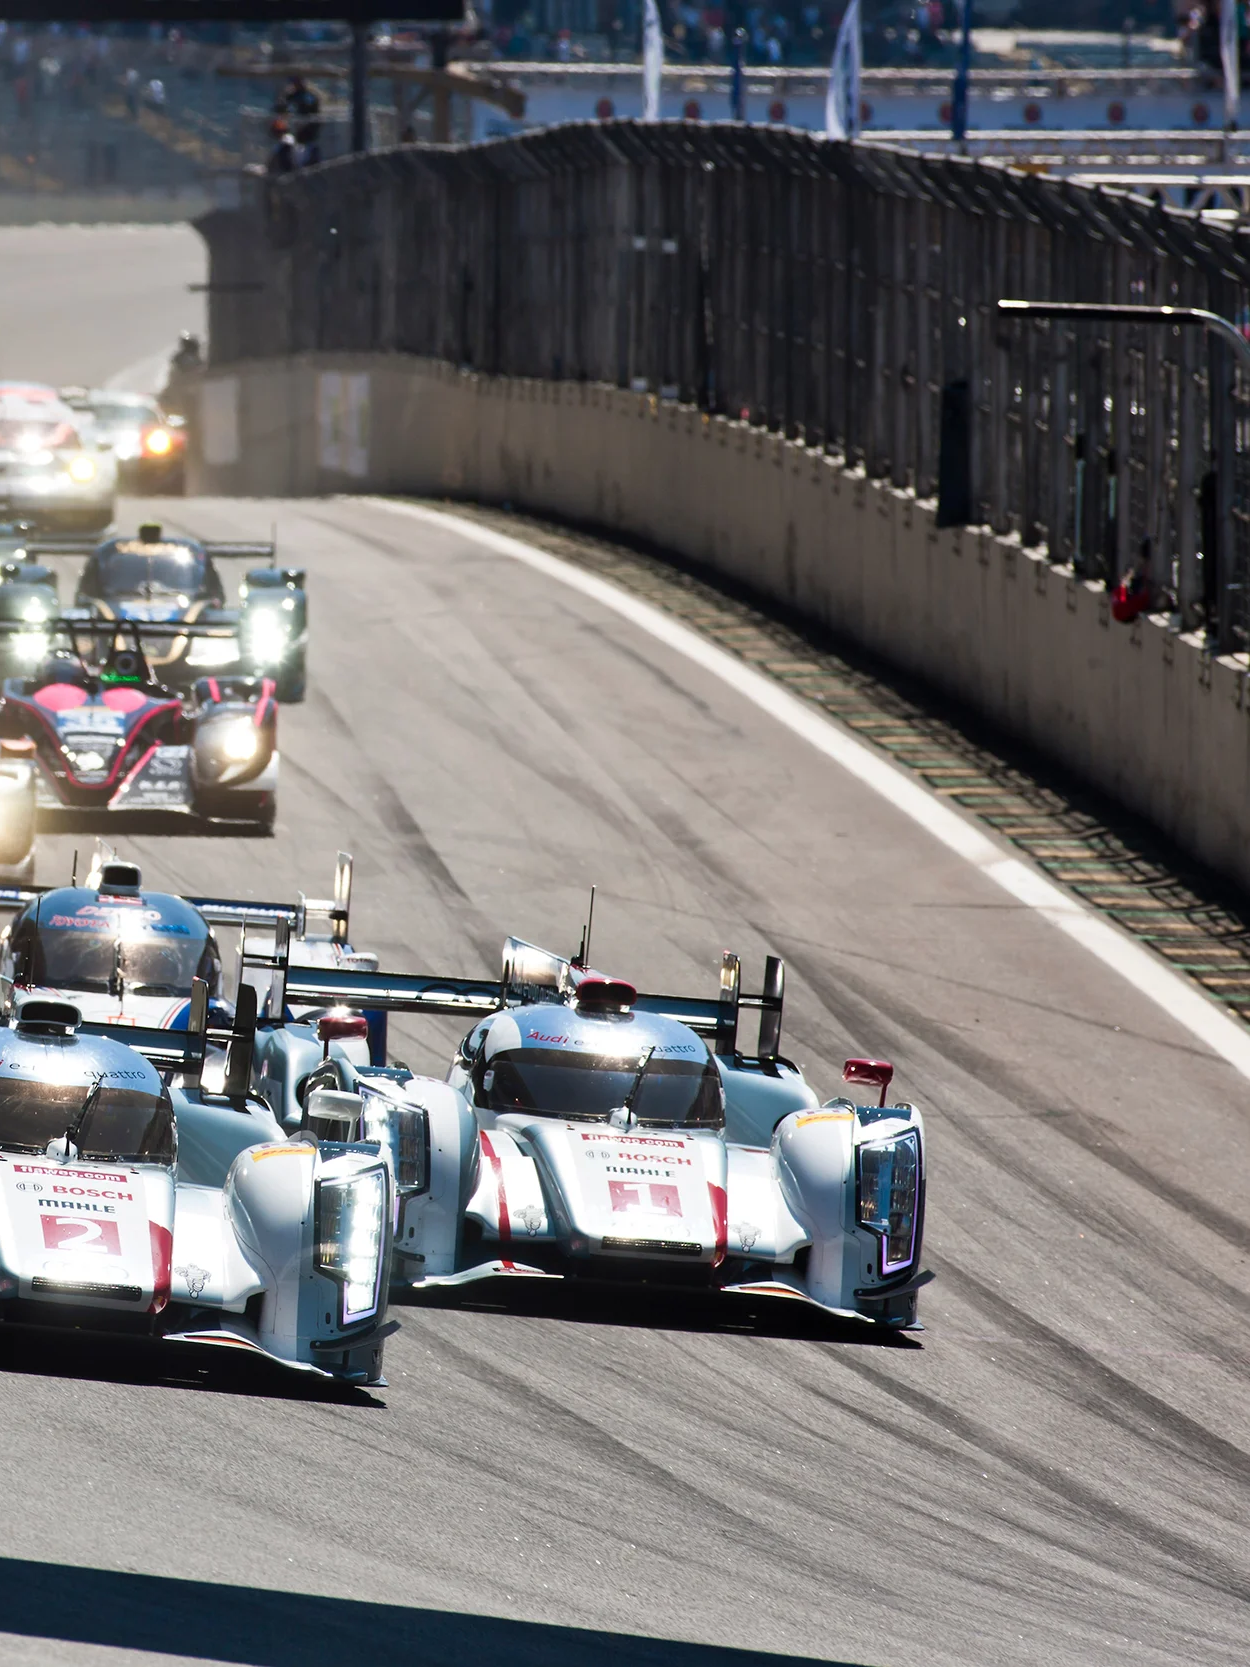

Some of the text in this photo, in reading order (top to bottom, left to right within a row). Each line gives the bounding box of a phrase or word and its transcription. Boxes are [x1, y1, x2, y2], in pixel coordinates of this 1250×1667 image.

[526, 1031, 569, 1044] Audi
[83, 1069, 146, 1081] quattro
[618, 1152, 692, 1166] BOSCH
[52, 1185, 133, 1201] BOSCH
[623, 1182, 667, 1215] 1
[38, 1199, 116, 1213] MAHLE
[56, 1216, 109, 1254] 2
